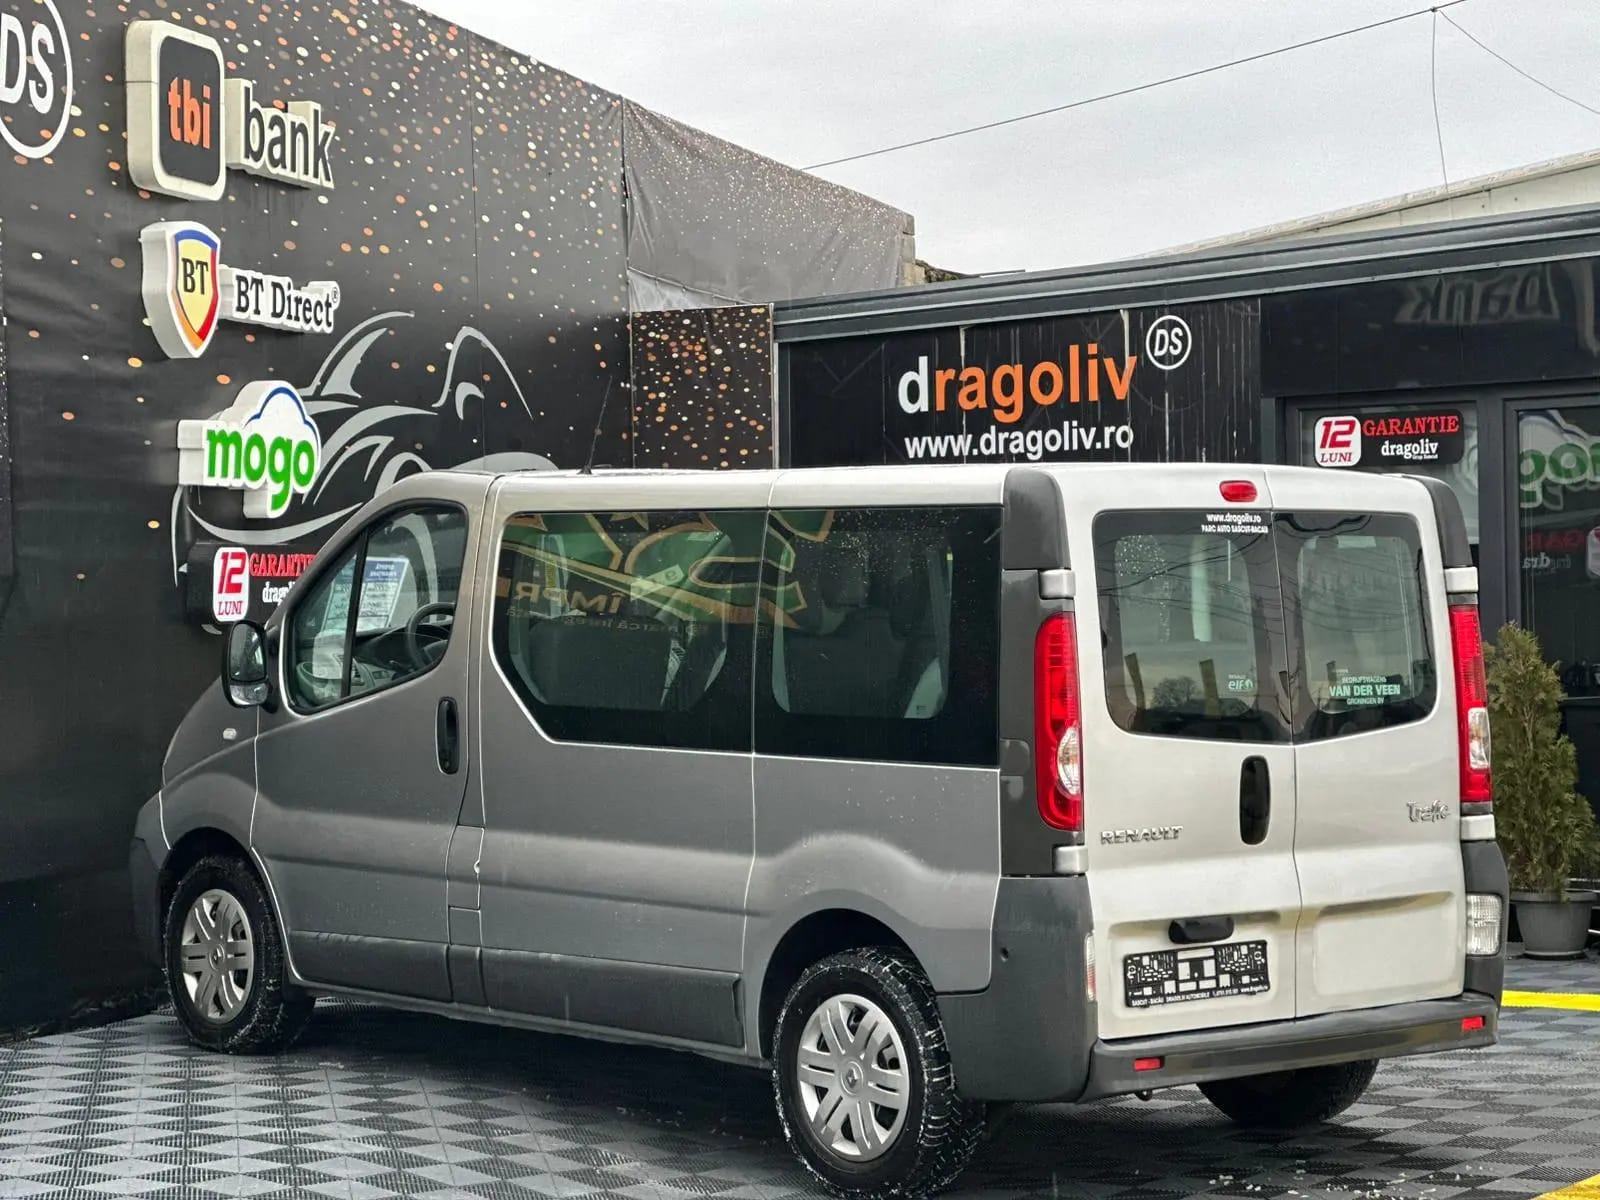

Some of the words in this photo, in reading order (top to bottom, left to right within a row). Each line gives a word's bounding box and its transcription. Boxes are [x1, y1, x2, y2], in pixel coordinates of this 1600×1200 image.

[1, 13, 55, 114] DS
[168, 77, 211, 149] tbi
[244, 86, 331, 182] bank
[182, 257, 209, 295] BT
[235, 275, 264, 315] BT
[1153, 327, 1183, 357] DS
[898, 343, 1137, 424] dragoliv
[904, 421, 1134, 461] www.dragoliv.ro
[1319, 419, 1356, 449] 12
[1362, 415, 1460, 436] GARANTIE
[1320, 451, 1353, 464] LUNI
[1381, 438, 1439, 460] dragoliv
[207, 428, 315, 511] mogo
[217, 552, 247, 594] 12
[217, 601, 243, 616] LUNI
[1328, 685, 1351, 697] VAN
[1353, 685, 1373, 696] DER
[1375, 684, 1400, 695] VEEN
[1100, 825, 1184, 845] RENAULT
